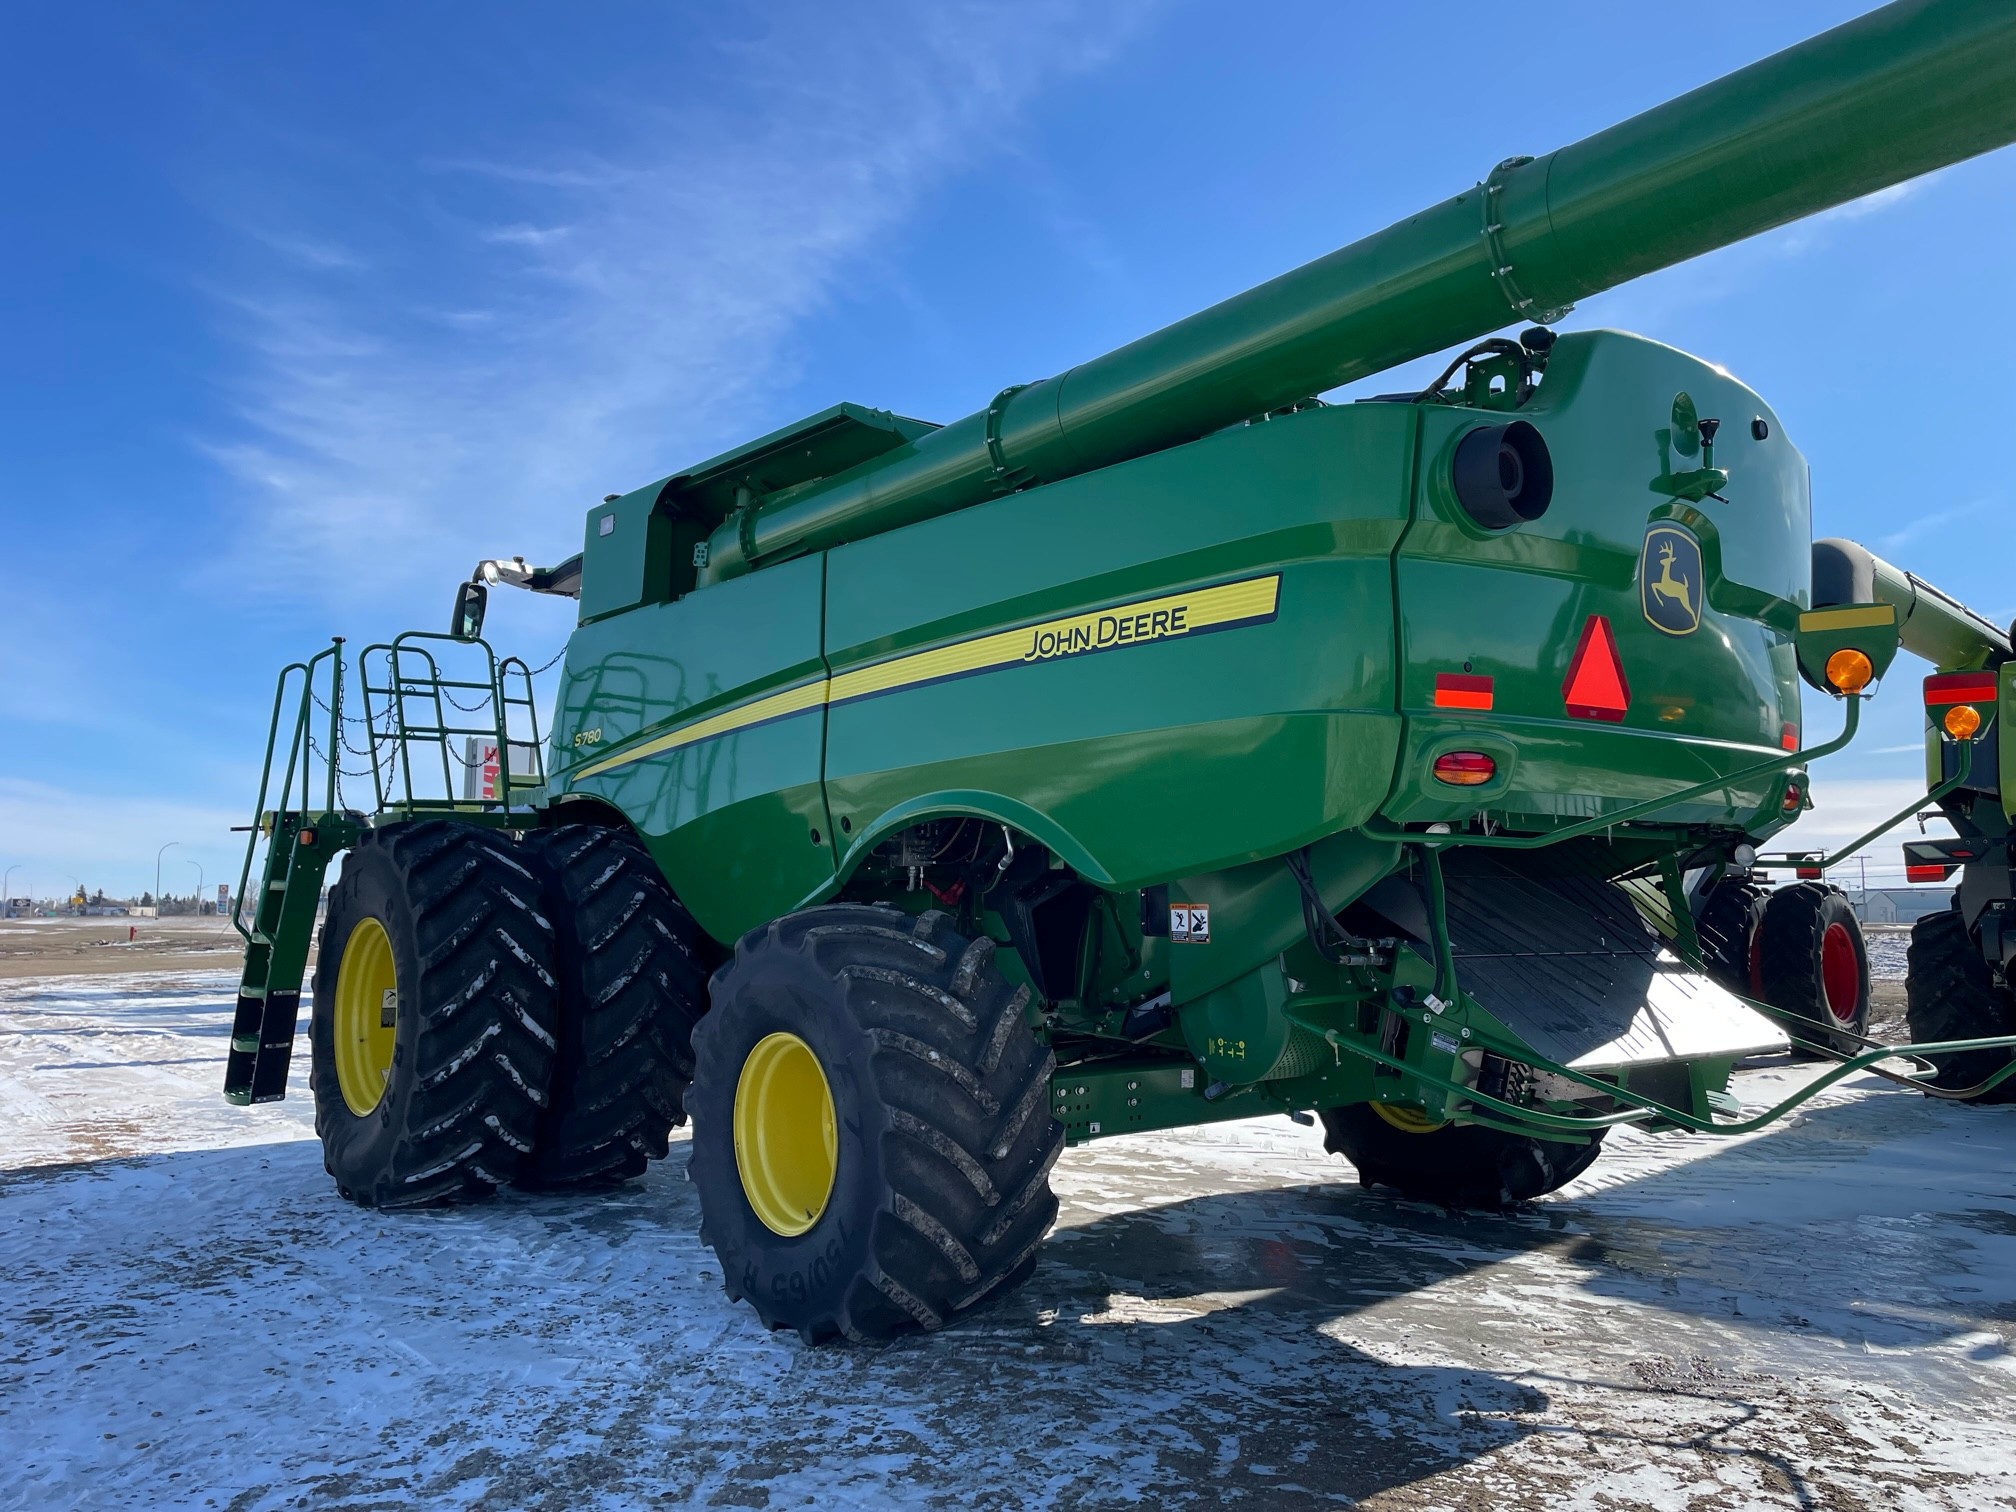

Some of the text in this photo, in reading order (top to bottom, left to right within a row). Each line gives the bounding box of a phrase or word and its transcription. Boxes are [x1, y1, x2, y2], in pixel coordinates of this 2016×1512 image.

[1024, 605, 1189, 660] JOHN DEERE
[574, 728, 602, 748] S780
